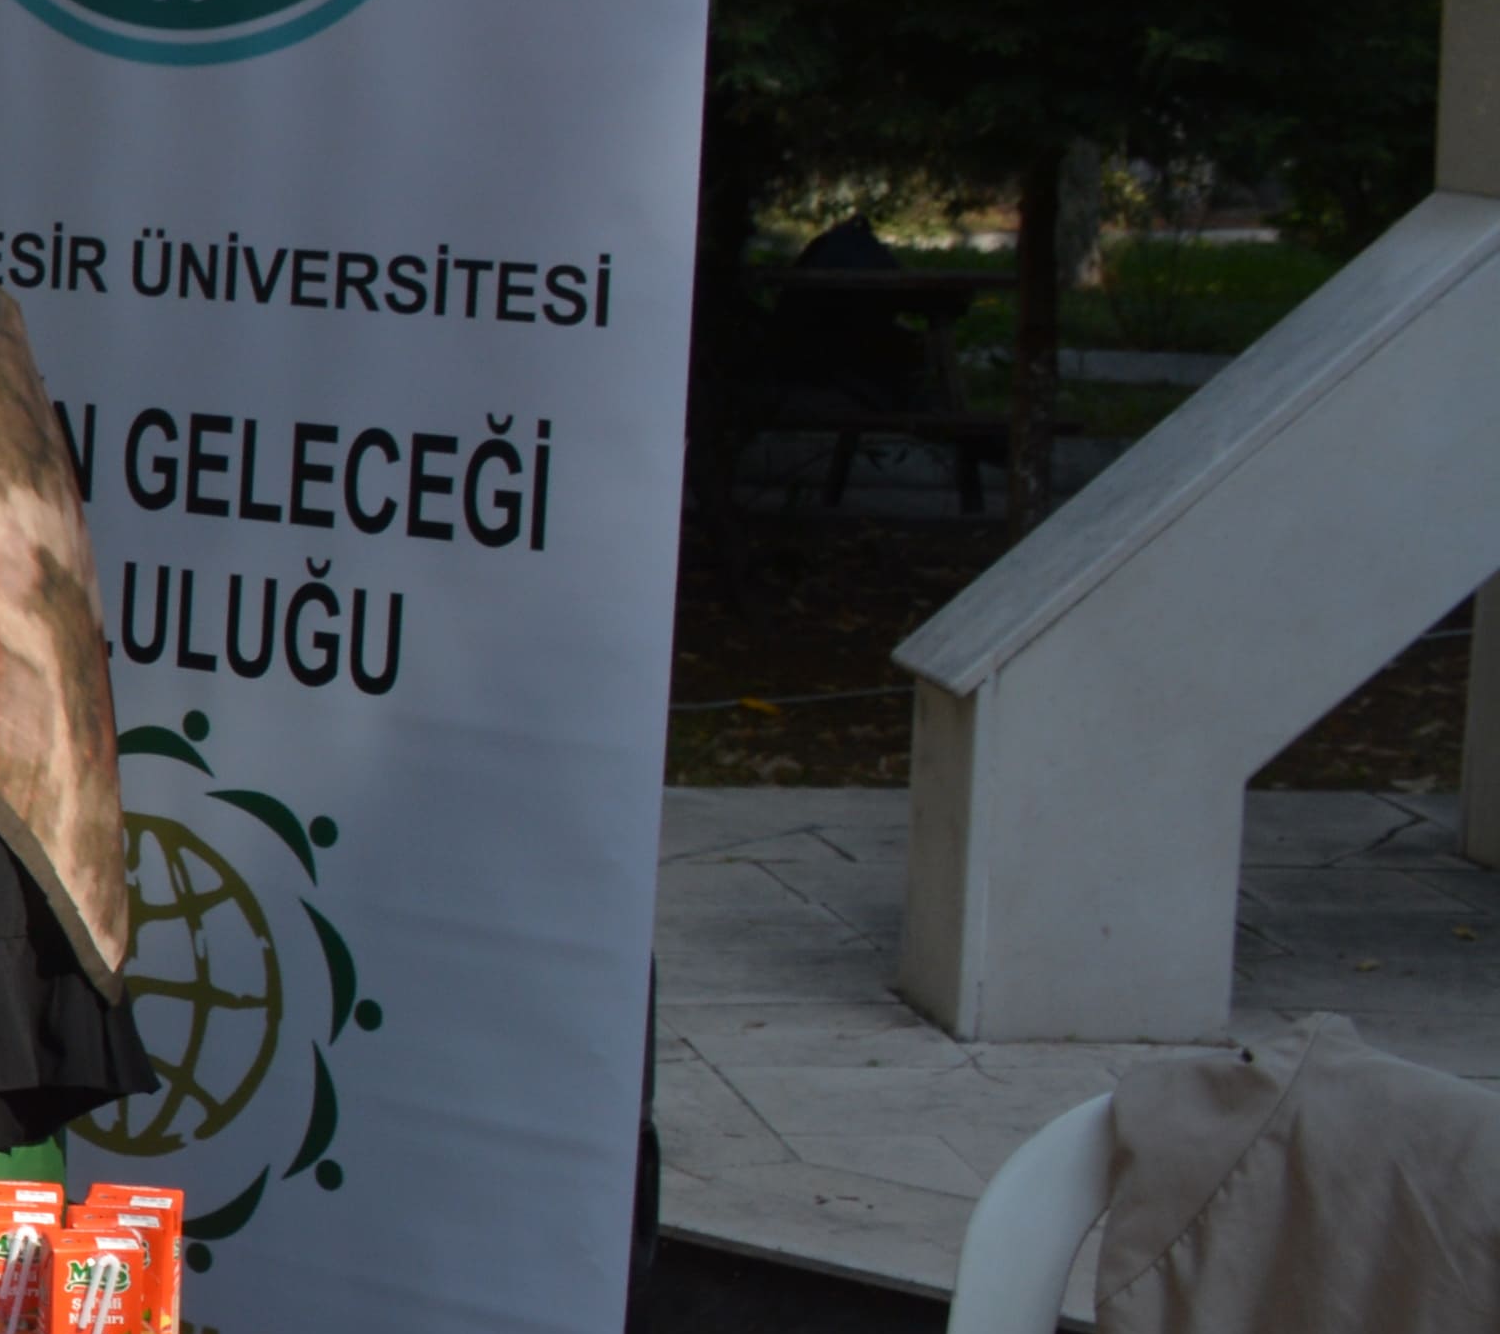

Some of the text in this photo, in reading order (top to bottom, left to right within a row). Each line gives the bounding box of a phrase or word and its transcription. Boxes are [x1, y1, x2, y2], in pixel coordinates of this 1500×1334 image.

[130, 228, 613, 329] ÜNİVERSİTESİ
[123, 406, 553, 553] GELECEĞİ
[108, 557, 405, 697] ULUĞU
